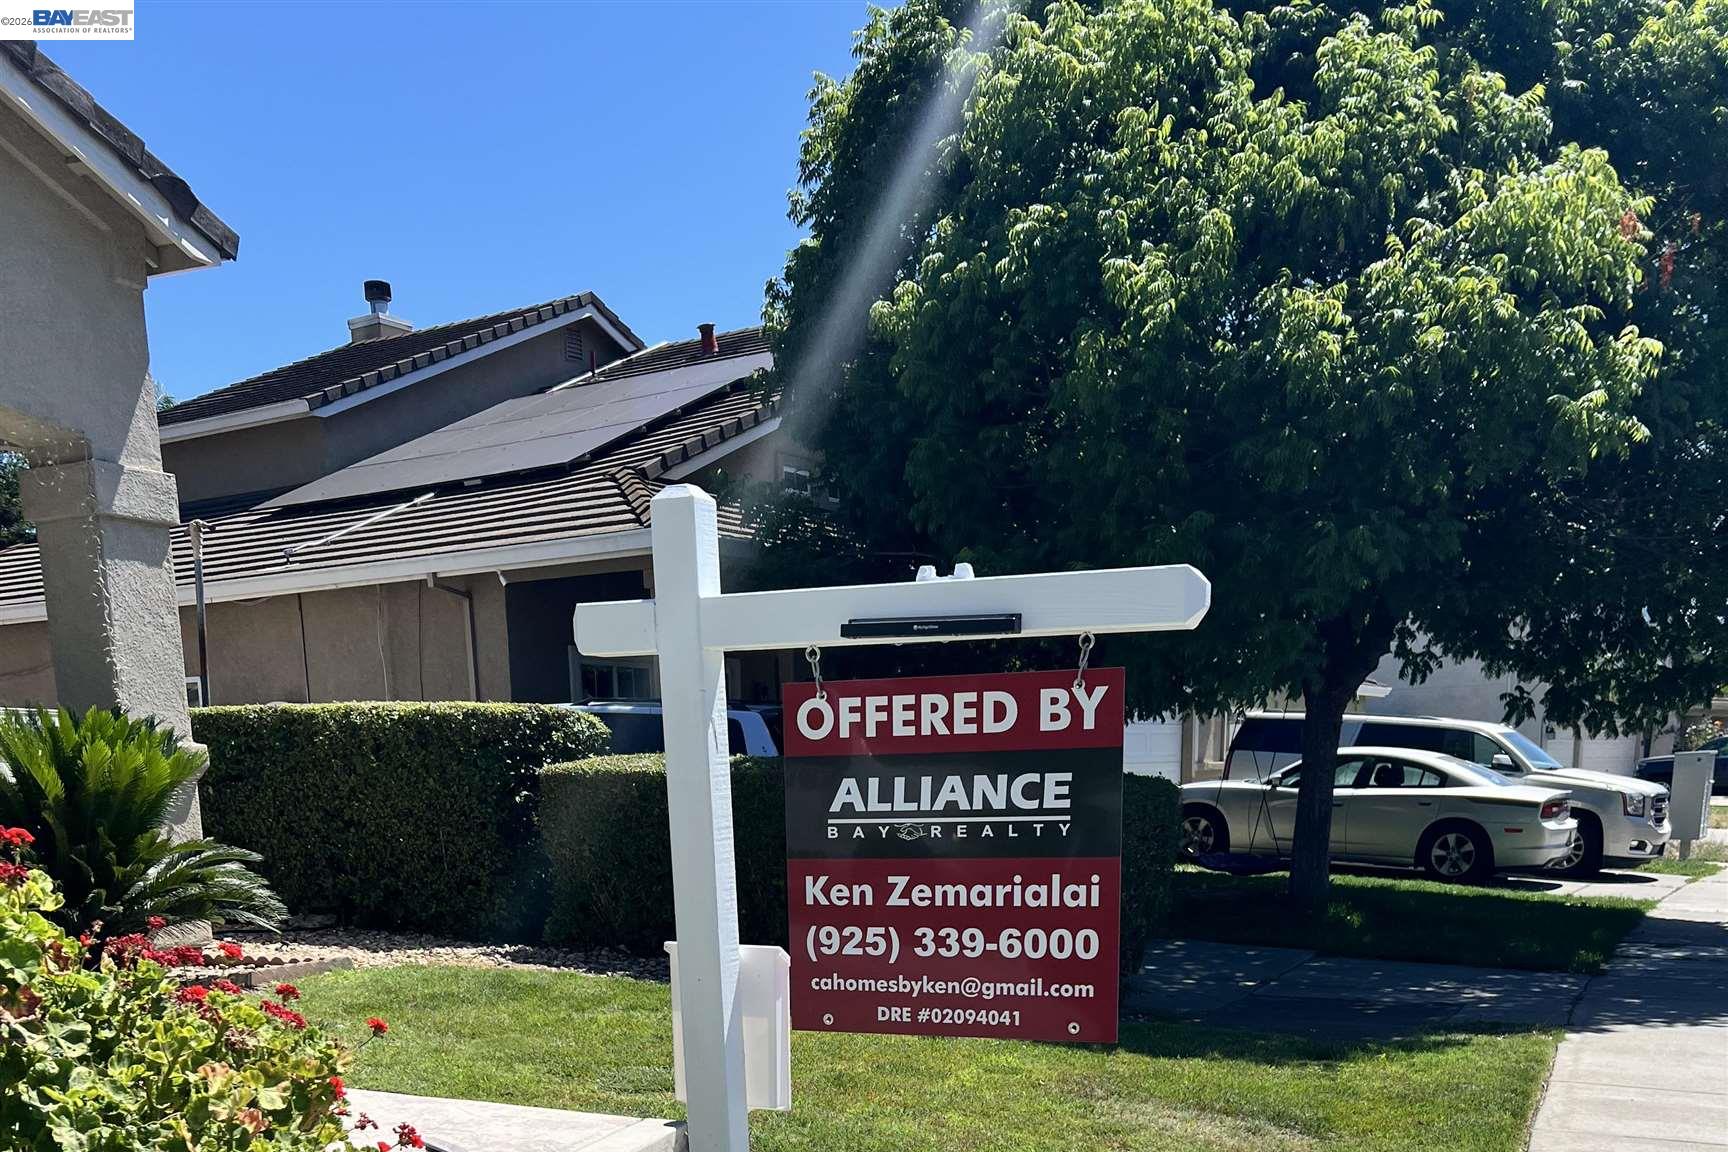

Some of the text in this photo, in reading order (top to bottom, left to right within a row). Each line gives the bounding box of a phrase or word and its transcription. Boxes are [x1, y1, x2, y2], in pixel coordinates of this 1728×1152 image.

[797, 685, 1109, 740] OFFERED BY
[828, 772, 1073, 813] ALLIANCE
[827, 822, 1071, 839] BAY REALTY
[804, 873, 1100, 908] Ken Zemarialai
[806, 925, 1100, 964] (925) 339-6000
[811, 972, 1095, 1000] cahomesbyken@gmail.com
[877, 1006, 1021, 1026] DRE #02094041
